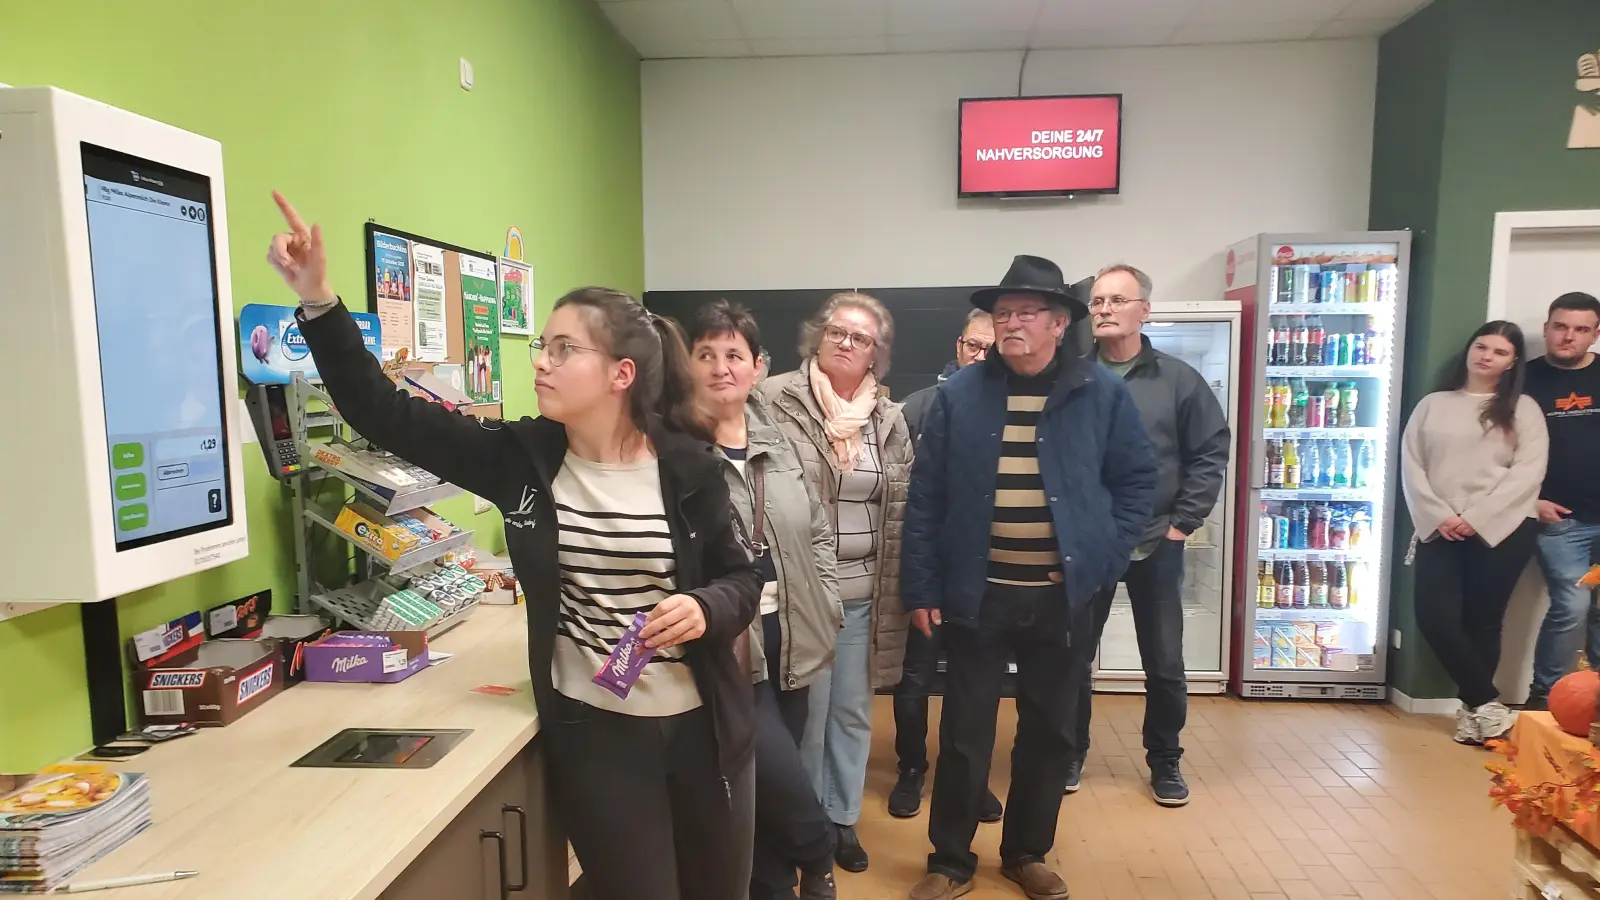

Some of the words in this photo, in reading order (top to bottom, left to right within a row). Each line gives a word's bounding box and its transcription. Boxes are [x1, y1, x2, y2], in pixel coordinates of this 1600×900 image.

[1031, 131, 1073, 144] DEINE
[1076, 129, 1103, 143] 24/7
[976, 145, 1103, 161] NAHVERSORGUNG
[357, 524, 384, 545] extra
[332, 655, 368, 673] Milka
[611, 643, 632, 677] Milka
[152, 673, 203, 687] SNICKERS
[239, 666, 272, 701] SNICKERS
